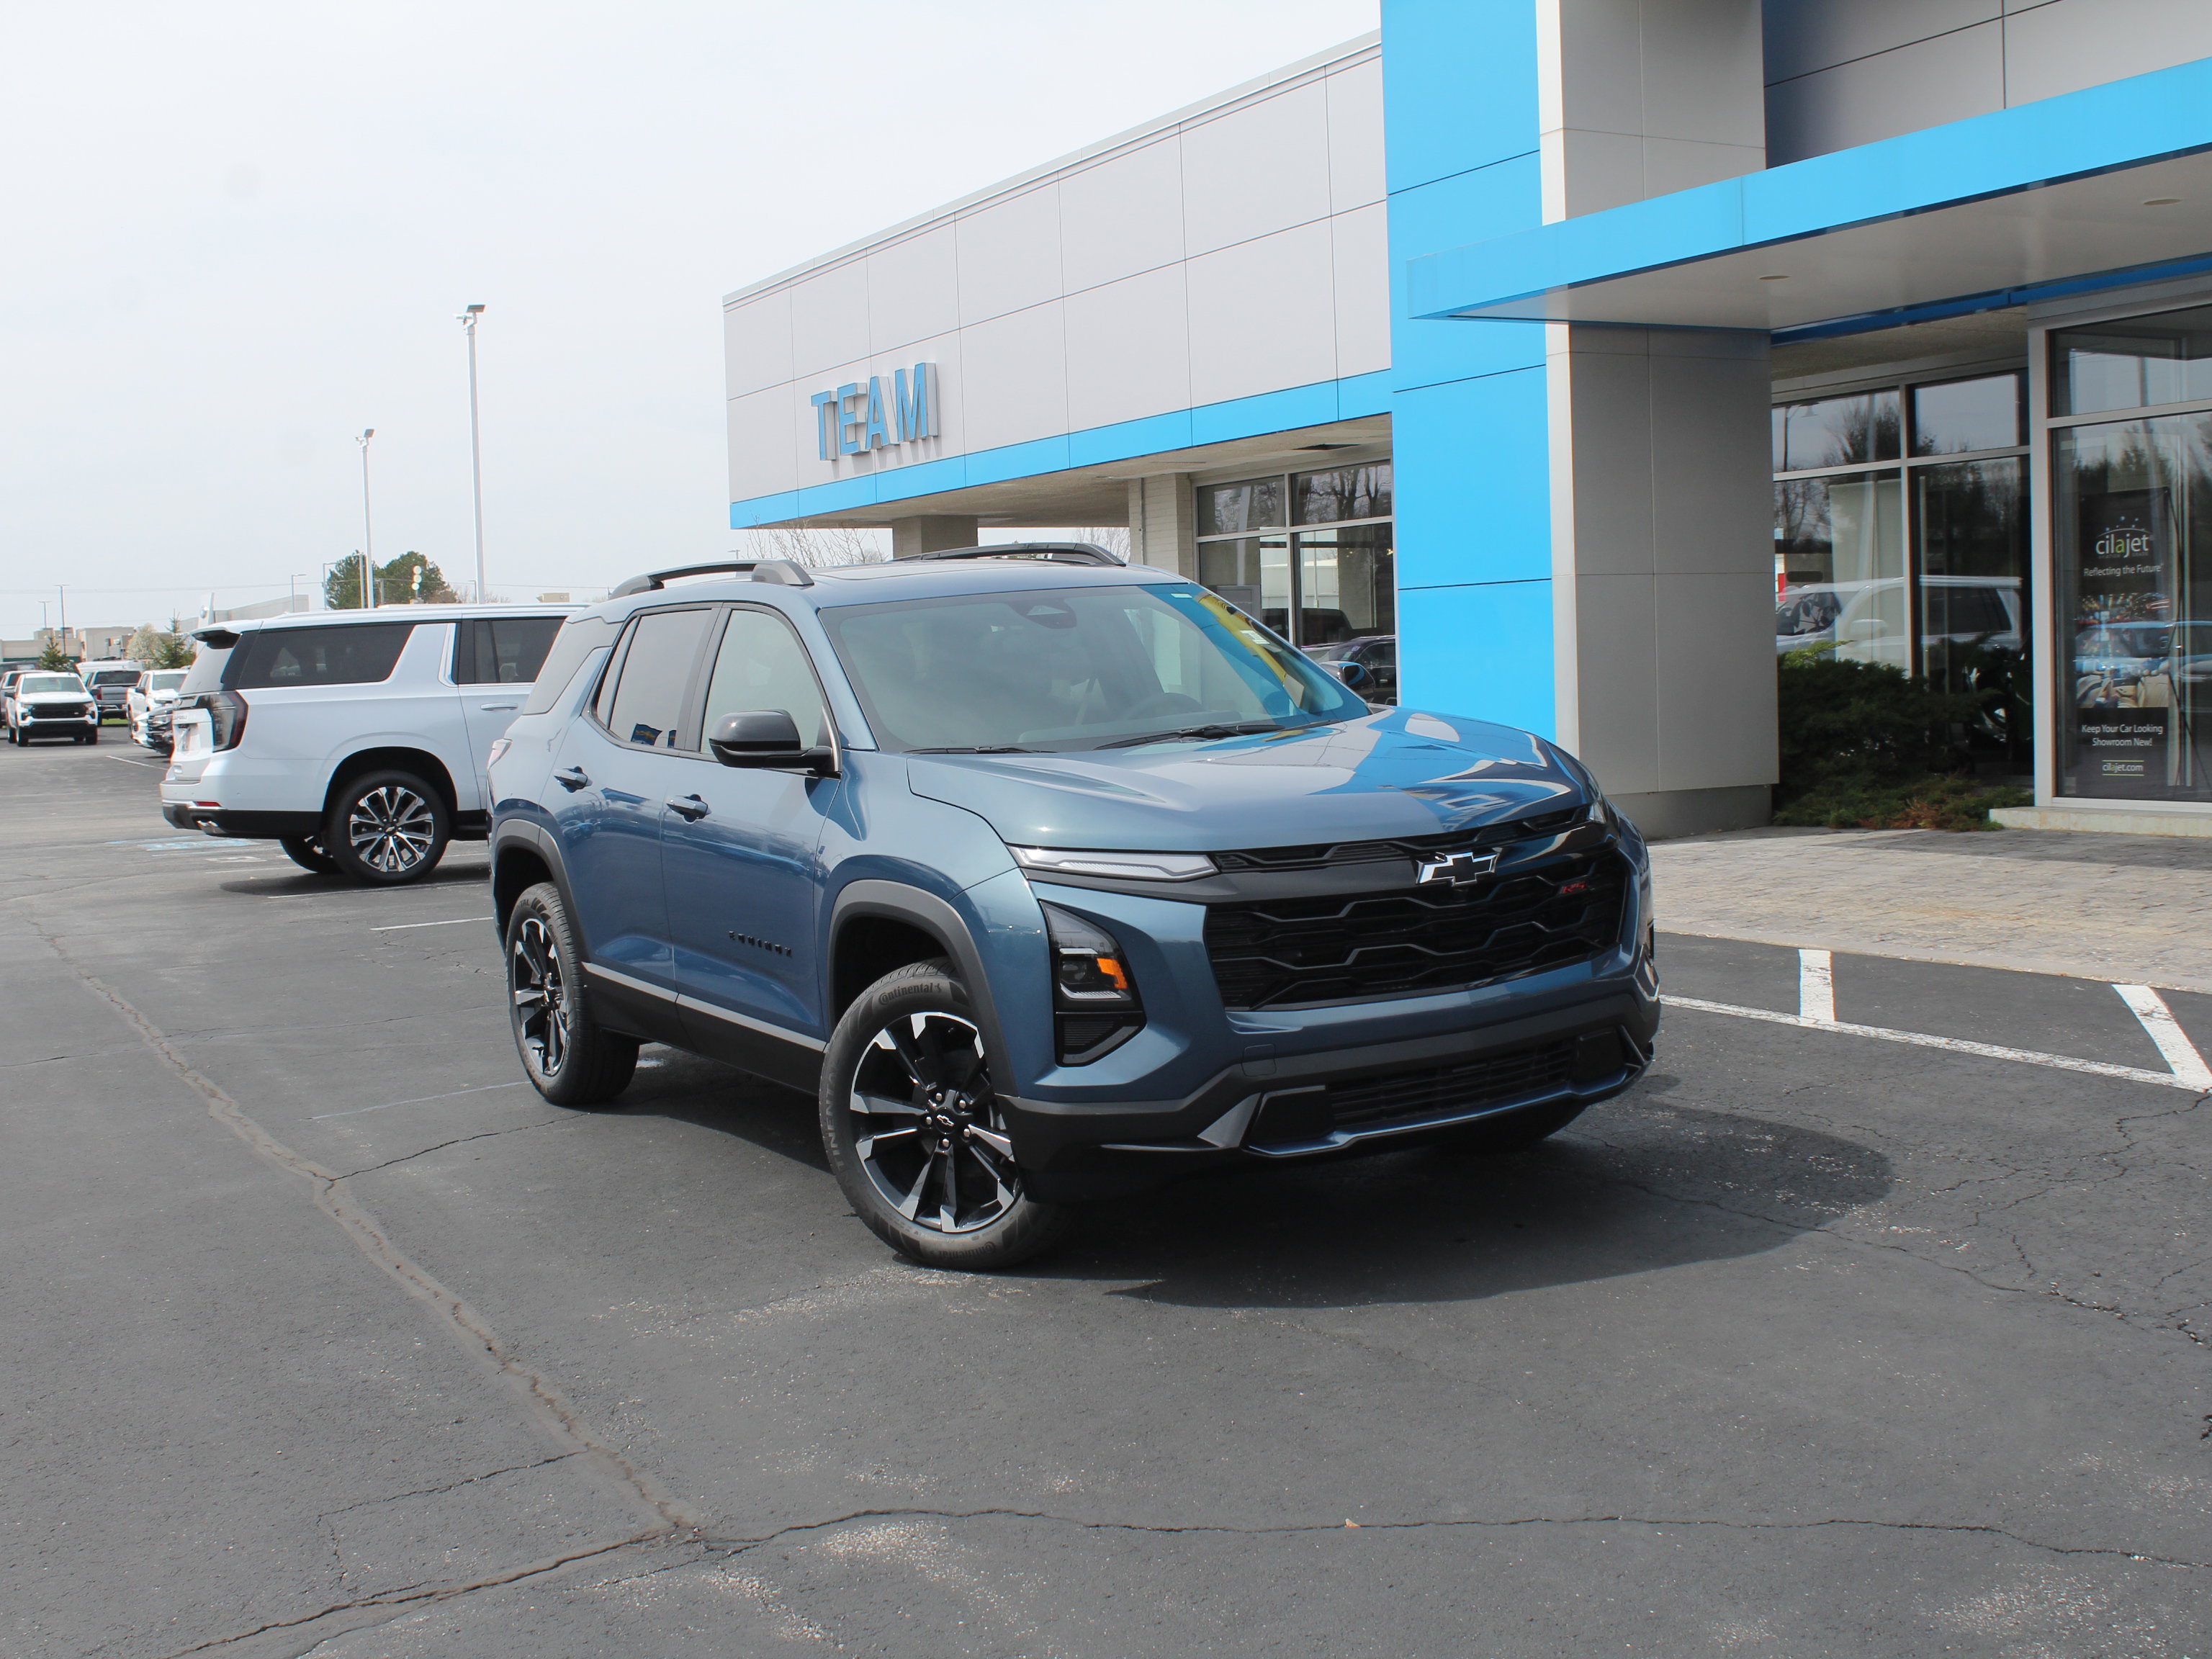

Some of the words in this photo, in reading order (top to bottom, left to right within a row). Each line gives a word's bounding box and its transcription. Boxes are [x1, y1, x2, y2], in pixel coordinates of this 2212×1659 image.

[811, 361, 938, 461] TEAM
[2095, 533, 2149, 558] cilajet
[2083, 566, 2122, 577] Reflecting
[2122, 565, 2136, 575] the
[2081, 724, 2101, 734] Keep
[2101, 724, 2119, 733] Your
[2119, 724, 2133, 733] Car
[2133, 724, 2164, 735] Looking
[2092, 737, 2132, 746] Showroom
[2133, 737, 2153, 746] New!
[2102, 763, 2144, 773] cilajet.com
[729, 930, 792, 958] EQUINOX
[878, 982, 934, 1006] Continental
